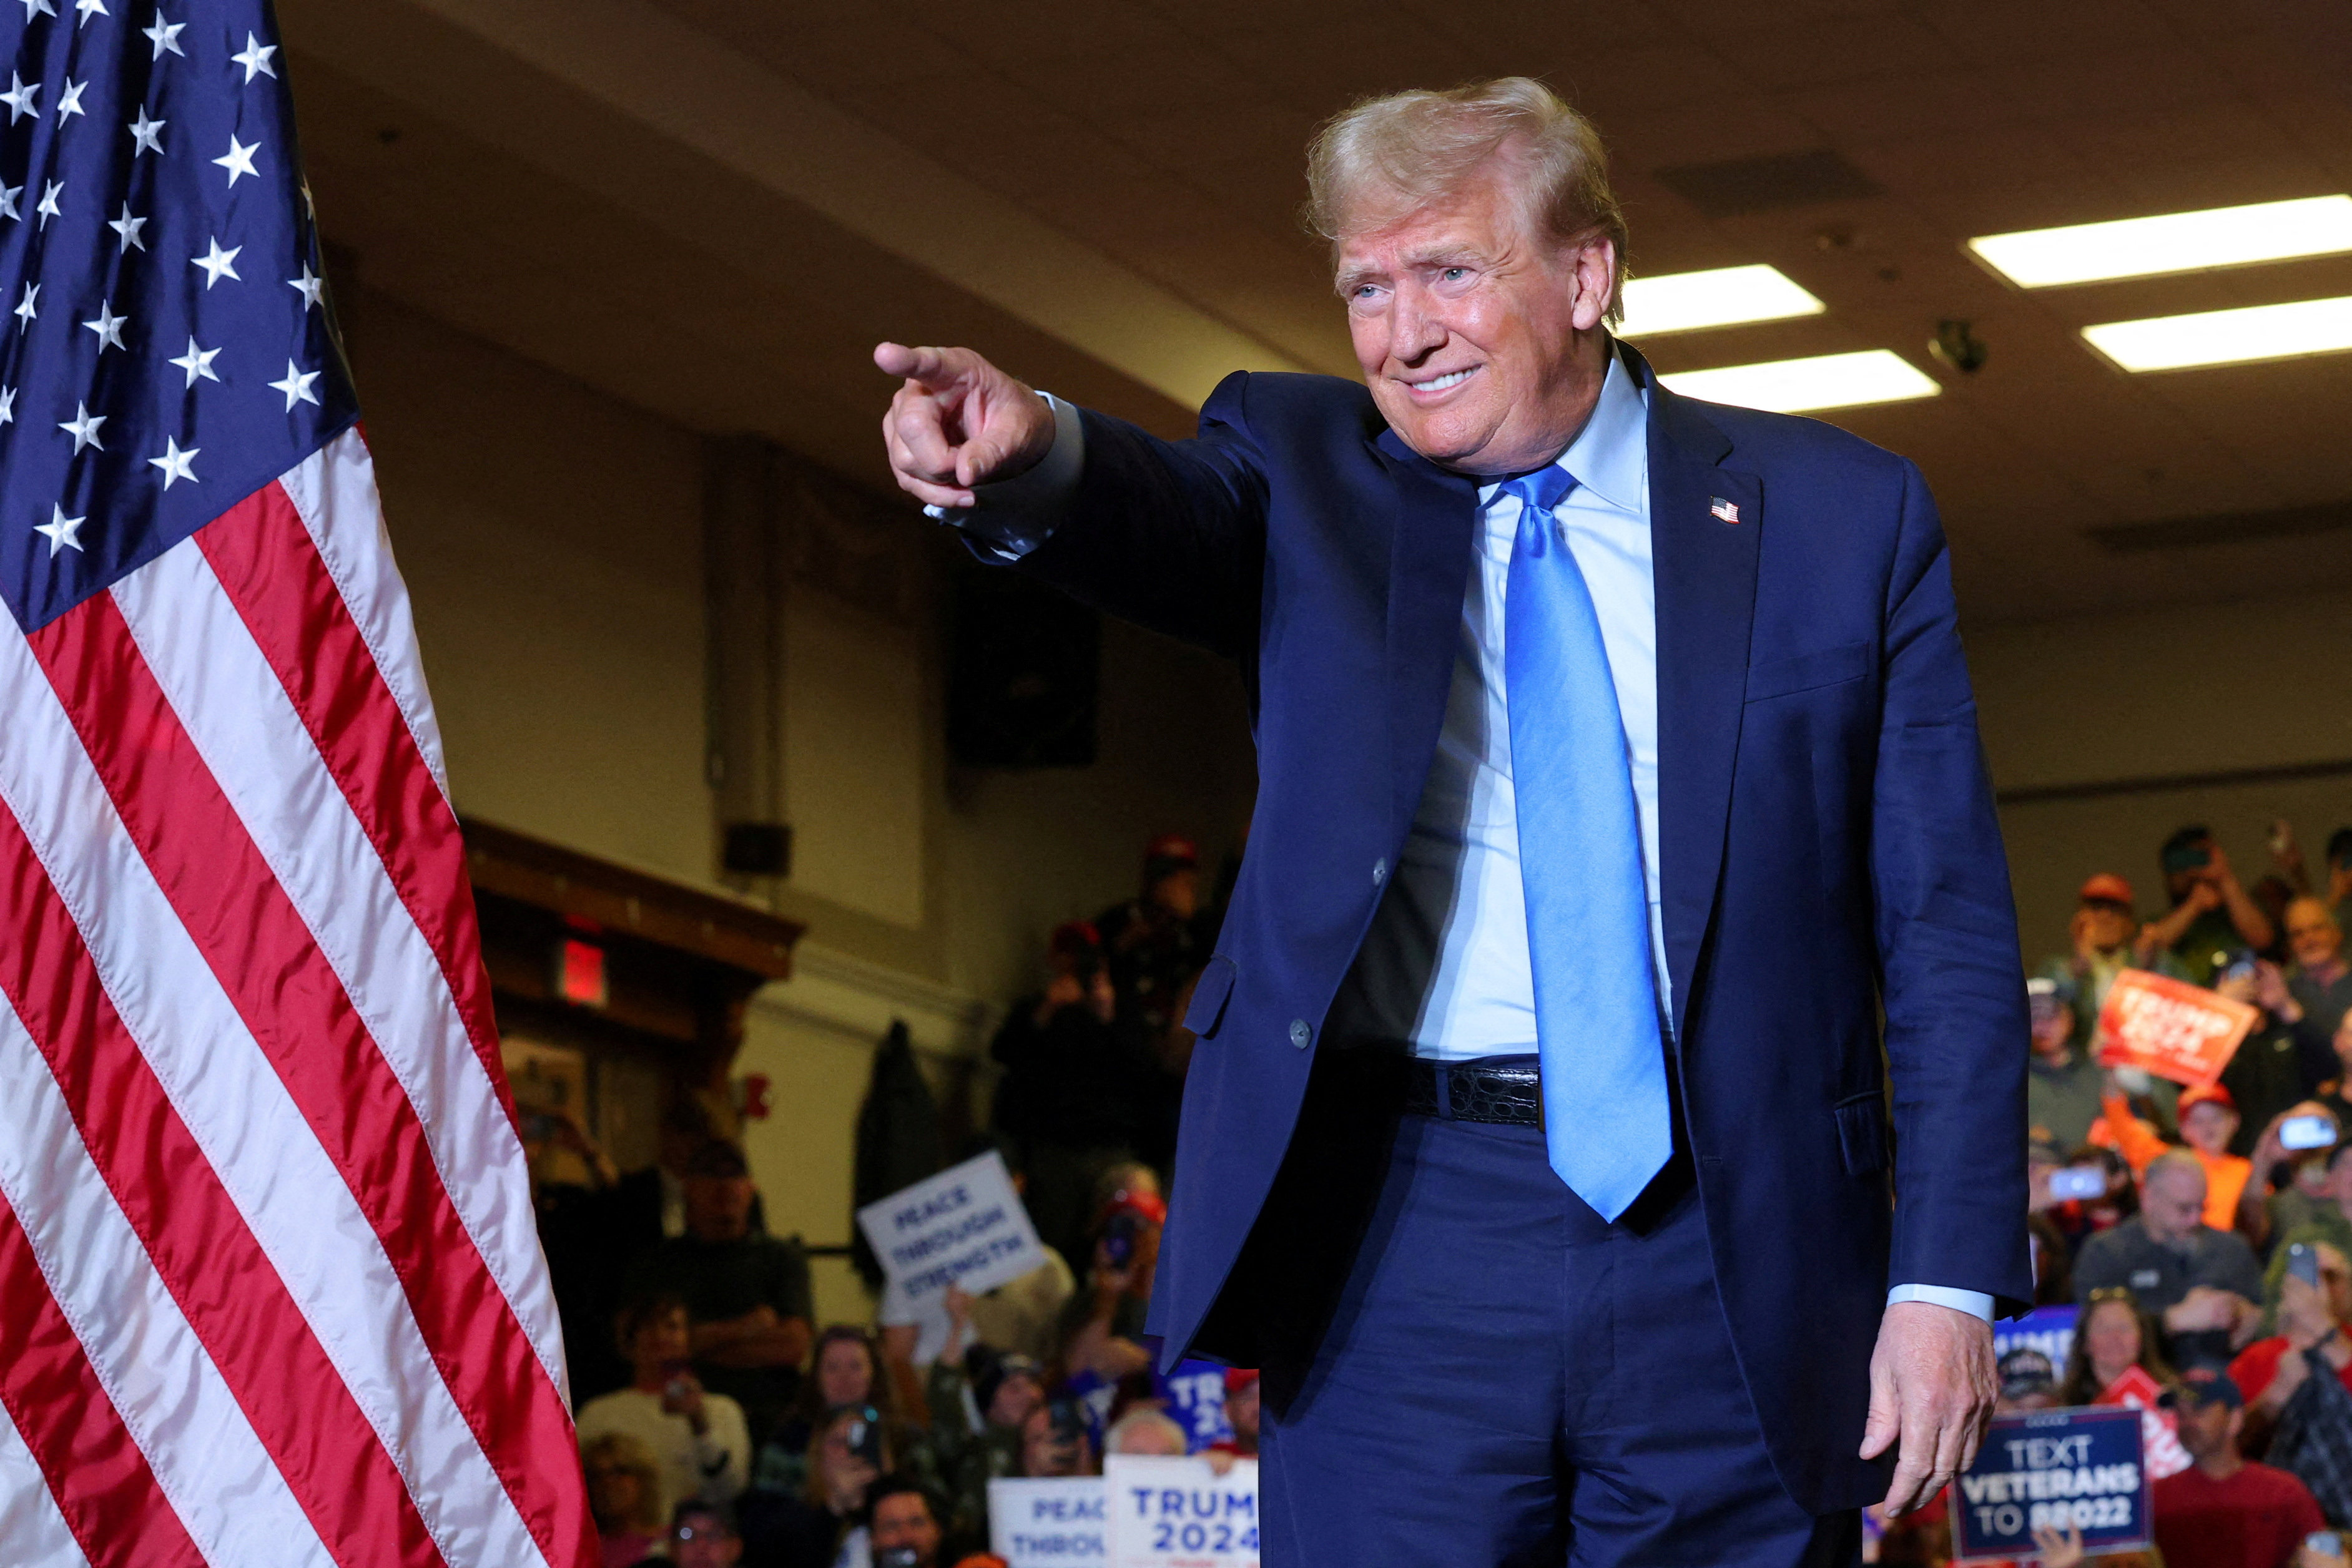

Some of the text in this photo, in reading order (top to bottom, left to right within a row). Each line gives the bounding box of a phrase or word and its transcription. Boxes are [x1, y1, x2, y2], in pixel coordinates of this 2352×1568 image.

[893, 1183, 972, 1231] PEACE
[891, 1203, 1008, 1266] THROUGH
[2004, 1434, 2093, 1469] TEXT
[1961, 1462, 2140, 1504] VETERANS
[1033, 1496, 1104, 1521] PEAC
[1131, 1488, 1256, 1518] TRUM
[1973, 1503, 2024, 1537] TO
[1153, 1522, 1259, 1552] 2024
